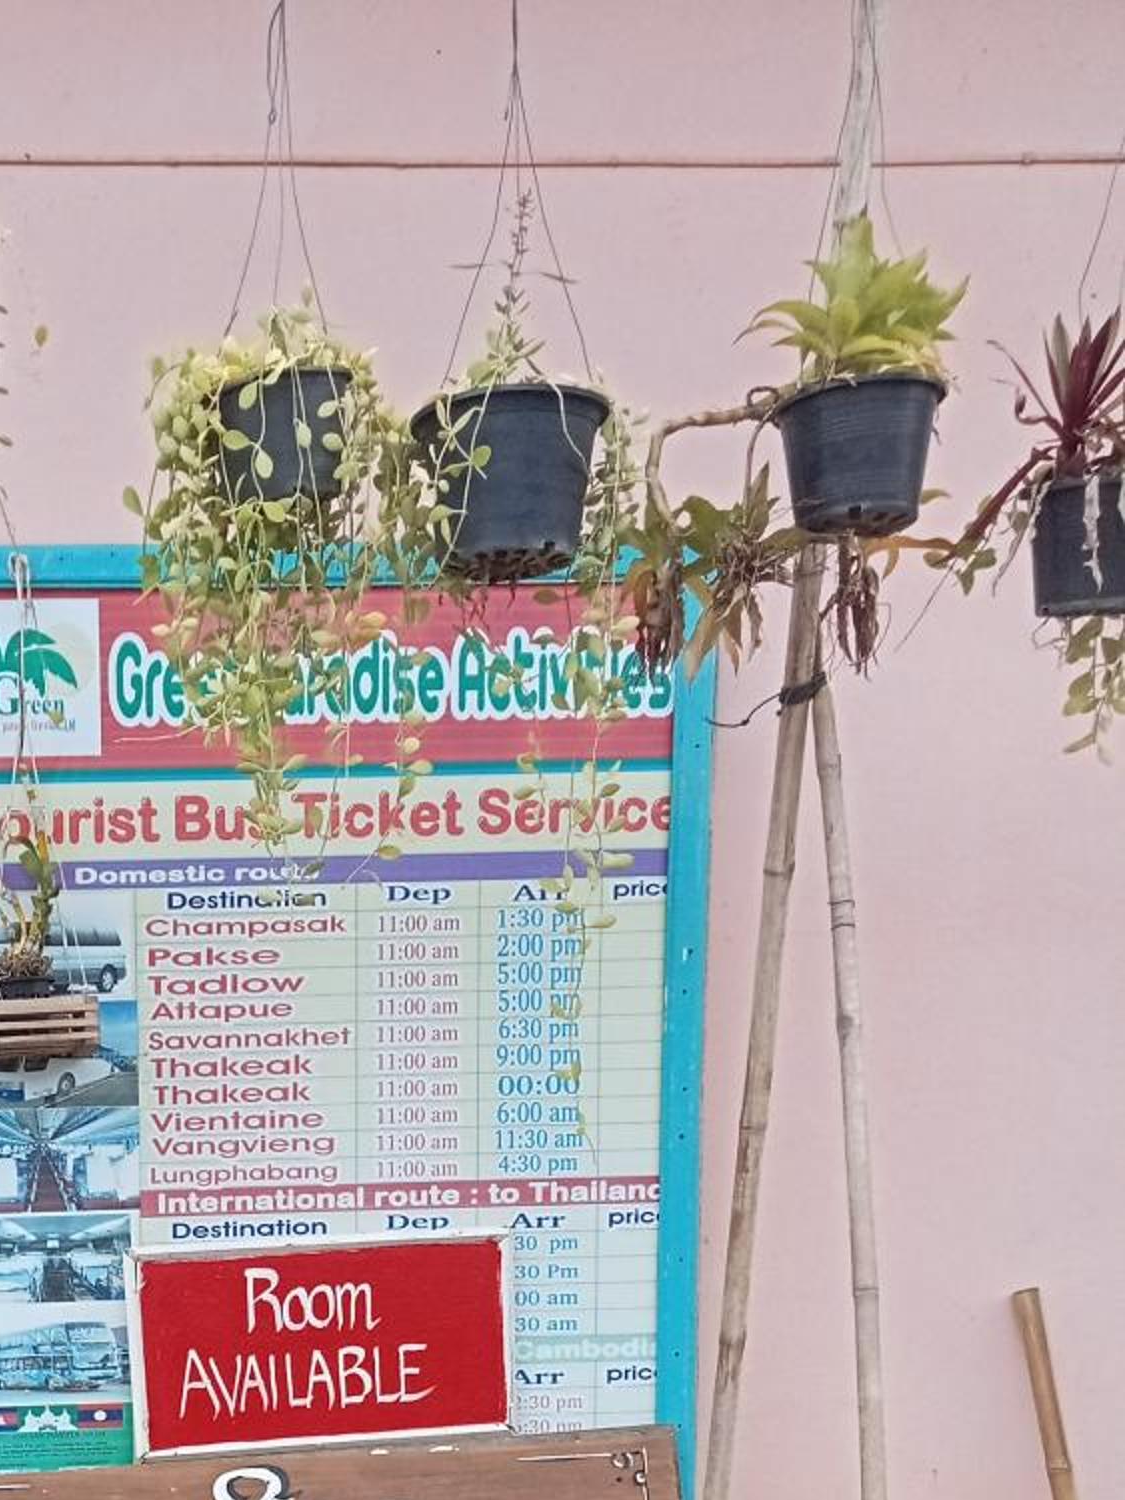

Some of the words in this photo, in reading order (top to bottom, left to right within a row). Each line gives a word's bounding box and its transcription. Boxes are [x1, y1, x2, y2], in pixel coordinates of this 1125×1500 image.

[175, 793, 277, 843] Bu
[291, 789, 466, 839] Ticket
[477, 787, 670, 835] Service
[75, 866, 225, 885] Domestic
[388, 885, 452, 904] Dep
[145, 915, 348, 938] Champasak
[378, 915, 426, 933] 11:00
[433, 916, 460, 931] am
[498, 908, 544, 928] 1:30
[148, 946, 281, 967] Pakse
[377, 943, 426, 961] 11:00
[431, 944, 459, 959] am
[497, 934, 544, 957] 2:00
[550, 939, 585, 961] pm
[148, 974, 304, 996] Tadlow
[377, 970, 426, 989] 11:00
[431, 971, 458, 986] am
[498, 962, 544, 984] 5:00
[550, 967, 582, 990] pm
[151, 1001, 293, 1022] Attapue
[377, 998, 426, 1016] 11:00
[431, 1000, 458, 1014] am
[498, 989, 544, 1012] 5:00
[149, 1027, 350, 1051] Savannakhet
[377, 1026, 426, 1044] 11:00
[431, 1027, 458, 1041] am
[498, 1019, 542, 1039] 6:30
[549, 1022, 578, 1044] pm
[150, 1054, 313, 1079] Thakeak
[377, 1053, 425, 1070] 11:00
[431, 1055, 458, 1068] am
[496, 1045, 541, 1066] 9:00
[549, 1048, 581, 1071] pm
[152, 1082, 311, 1105] Thakeak
[377, 1080, 425, 1097] 11:00
[431, 1082, 458, 1095] am
[498, 1074, 580, 1096] 00:00
[150, 1110, 324, 1132] Vientaine
[377, 1107, 425, 1124] 11:00
[431, 1109, 458, 1123] am
[496, 1102, 541, 1123] 6:00
[550, 1105, 580, 1122] am
[152, 1135, 335, 1158] Vangvieng
[377, 1134, 425, 1151] 11:00
[431, 1136, 458, 1150] am
[495, 1129, 548, 1148] 11:30
[554, 1132, 582, 1147] am
[150, 1164, 338, 1186] Lungphabang
[377, 1161, 425, 1178] 11:00
[430, 1163, 458, 1177] am
[498, 1155, 541, 1173] 4:30
[549, 1157, 578, 1177] pm
[157, 1188, 364, 1214] International
[375, 1186, 460, 1207] route
[488, 1184, 520, 1203] to
[172, 1219, 327, 1239] Destination
[387, 1215, 449, 1230] Dep
[511, 1213, 566, 1228] Arr
[608, 1208, 660, 1228] pric
[550, 1238, 578, 1254] pm
[244, 1268, 382, 1333] Room
[547, 1292, 578, 1305] am
[546, 1318, 578, 1331] am
[515, 1338, 656, 1360] Cambodi
[179, 1343, 437, 1421] AVAILABLE
[514, 1368, 565, 1384] Arr
[606, 1365, 657, 1384] pric
